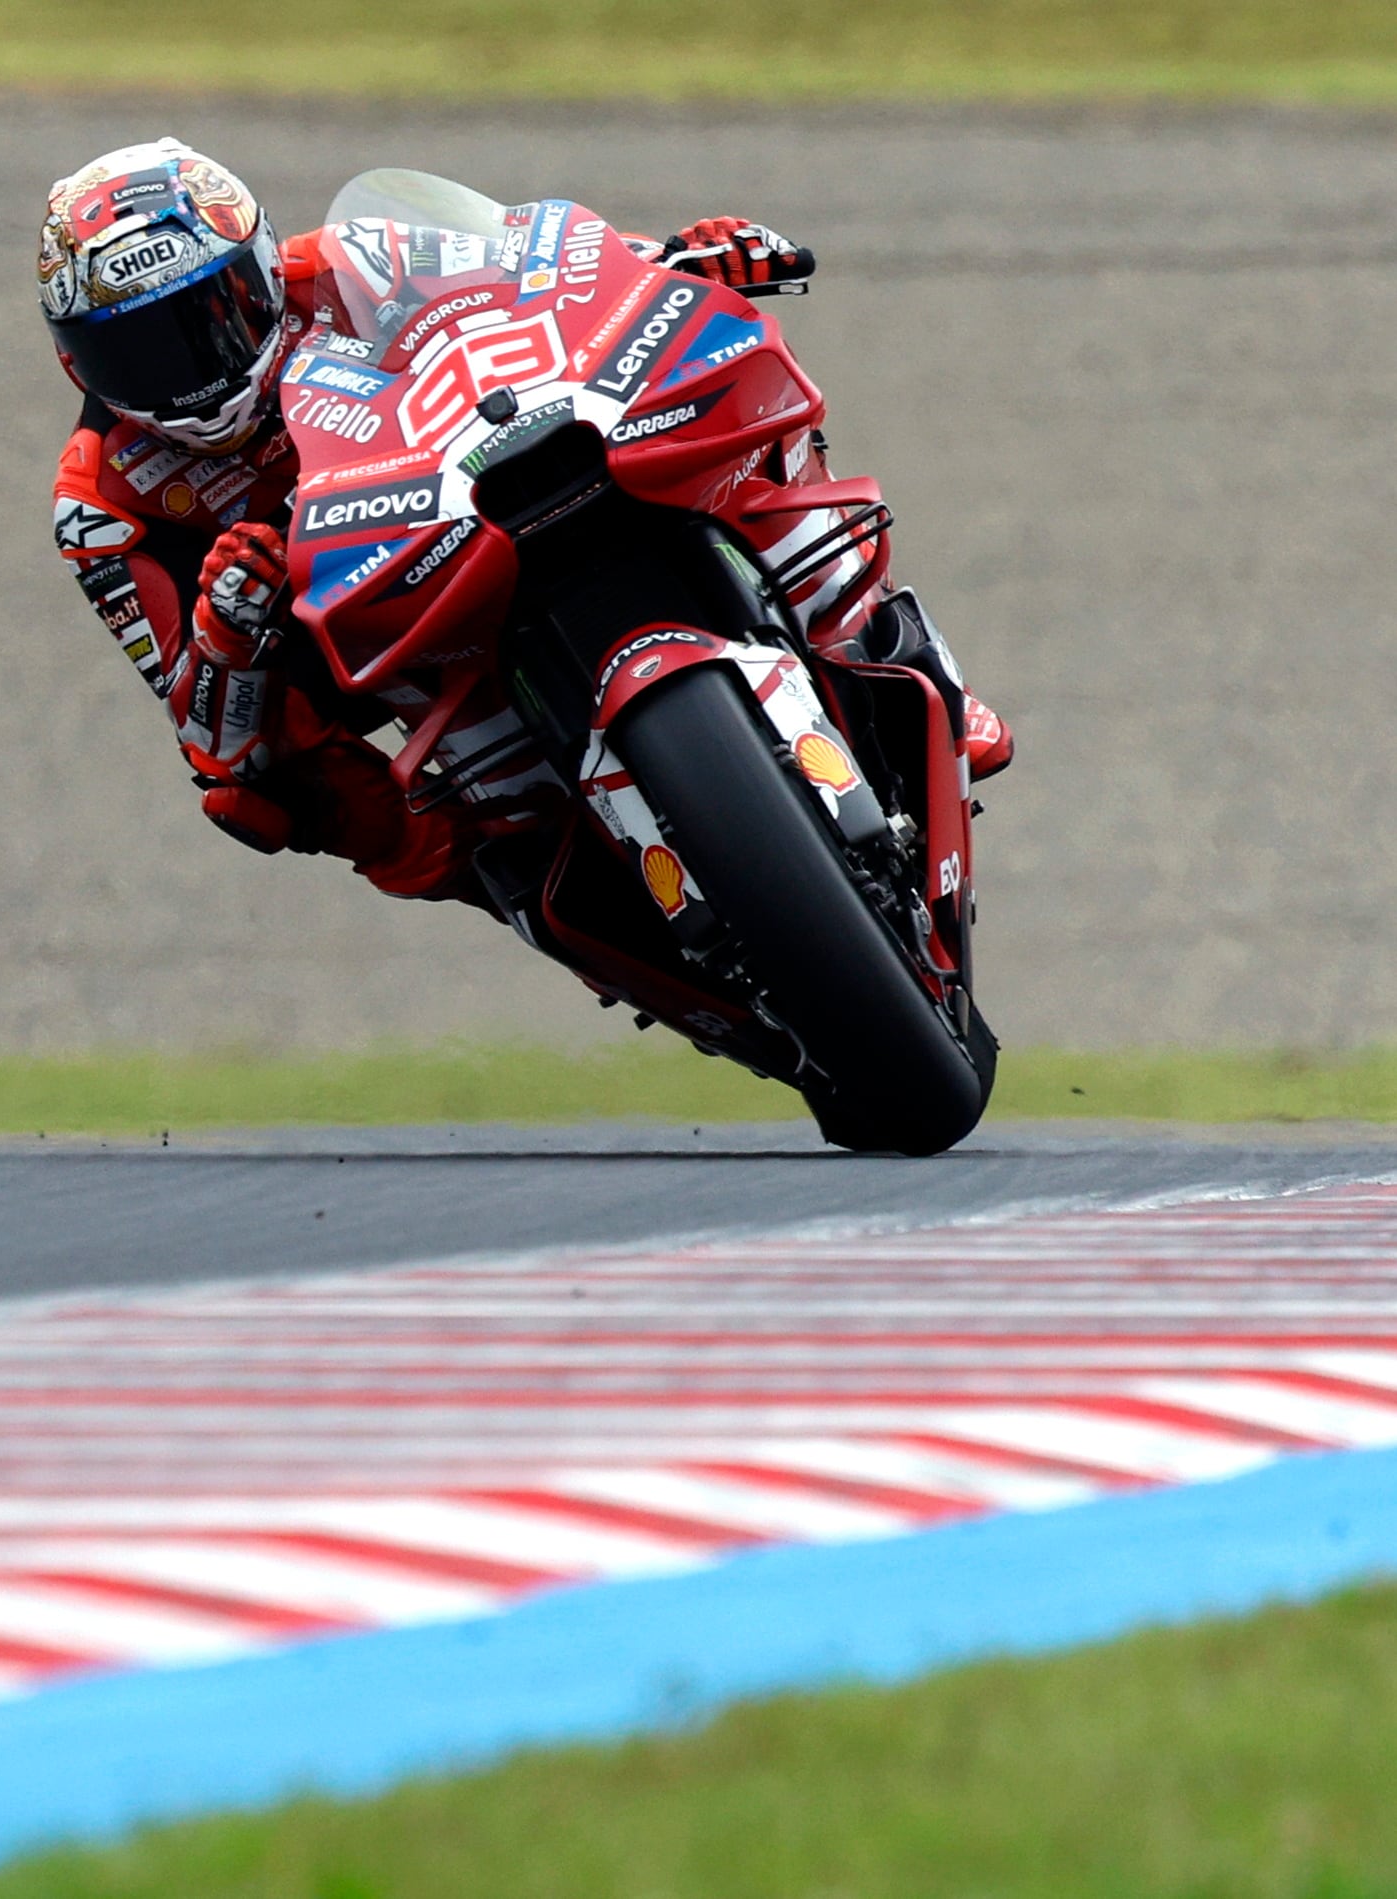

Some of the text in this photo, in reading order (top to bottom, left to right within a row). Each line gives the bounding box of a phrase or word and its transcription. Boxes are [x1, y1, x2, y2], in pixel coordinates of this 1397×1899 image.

[113, 183, 165, 200] Lenovo
[109, 239, 176, 282] SHOEI
[499, 229, 526, 273] WRS
[560, 219, 606, 285] riello
[399, 291, 494, 352] VARGROUP
[589, 271, 657, 349] FRECCIAROSSA
[328, 333, 374, 358] WRS
[597, 287, 695, 394] Lenovo
[707, 335, 759, 364] TIM
[306, 364, 383, 397] ADVANCE
[301, 395, 382, 444] riello
[483, 400, 572, 452] MONSTER
[611, 404, 697, 442] CARRERA
[333, 450, 431, 480] FRECCIAROSSA
[306, 488, 433, 531] Lenovo
[345, 545, 392, 585] TIM
[405, 517, 477, 586] CARRERA
[595, 631, 698, 707] Lenovo
[191, 664, 214, 723] Lenovo
[225, 675, 261, 729] Unipol
